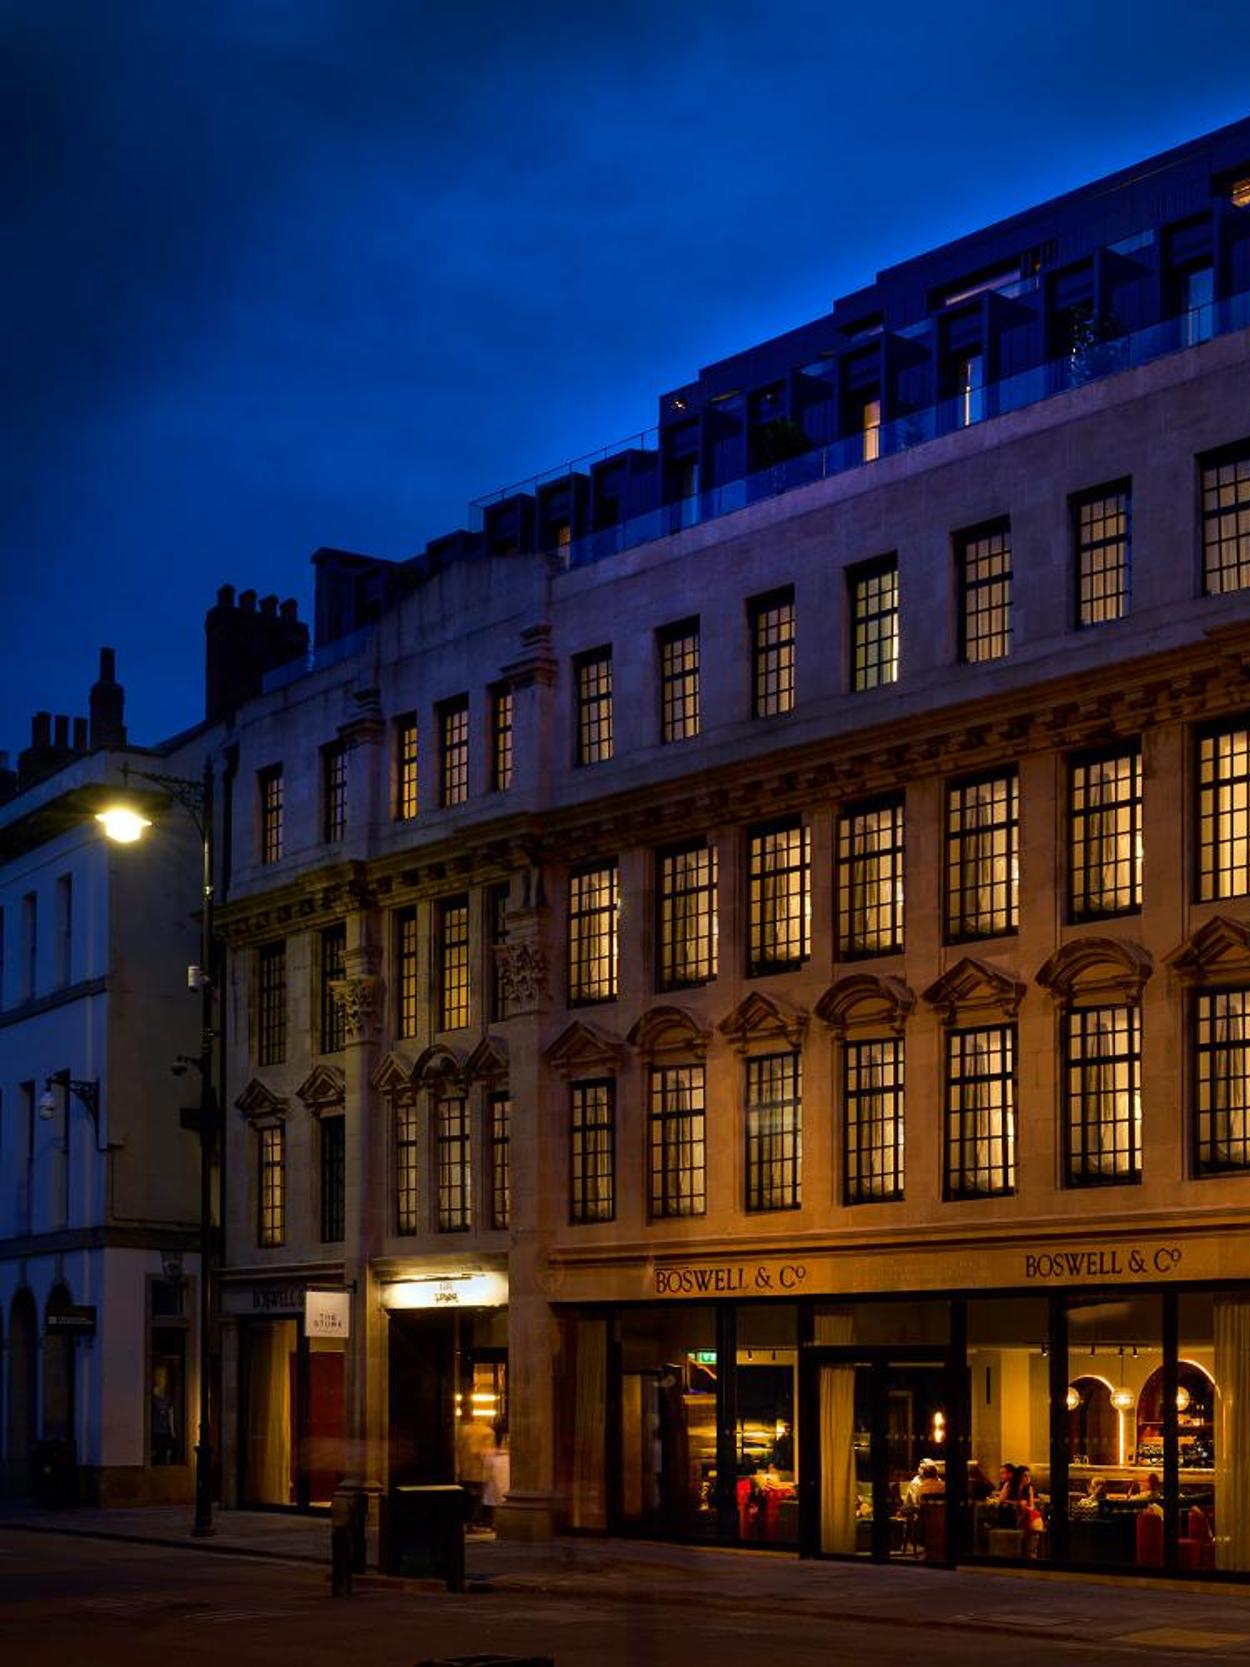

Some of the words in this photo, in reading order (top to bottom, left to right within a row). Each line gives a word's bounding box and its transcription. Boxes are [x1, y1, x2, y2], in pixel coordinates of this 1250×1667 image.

[1025, 1251, 1122, 1278] BOSWELL
[1128, 1250, 1148, 1273] &
[656, 1268, 748, 1294] BOSWELL
[755, 1266, 774, 1290] &
